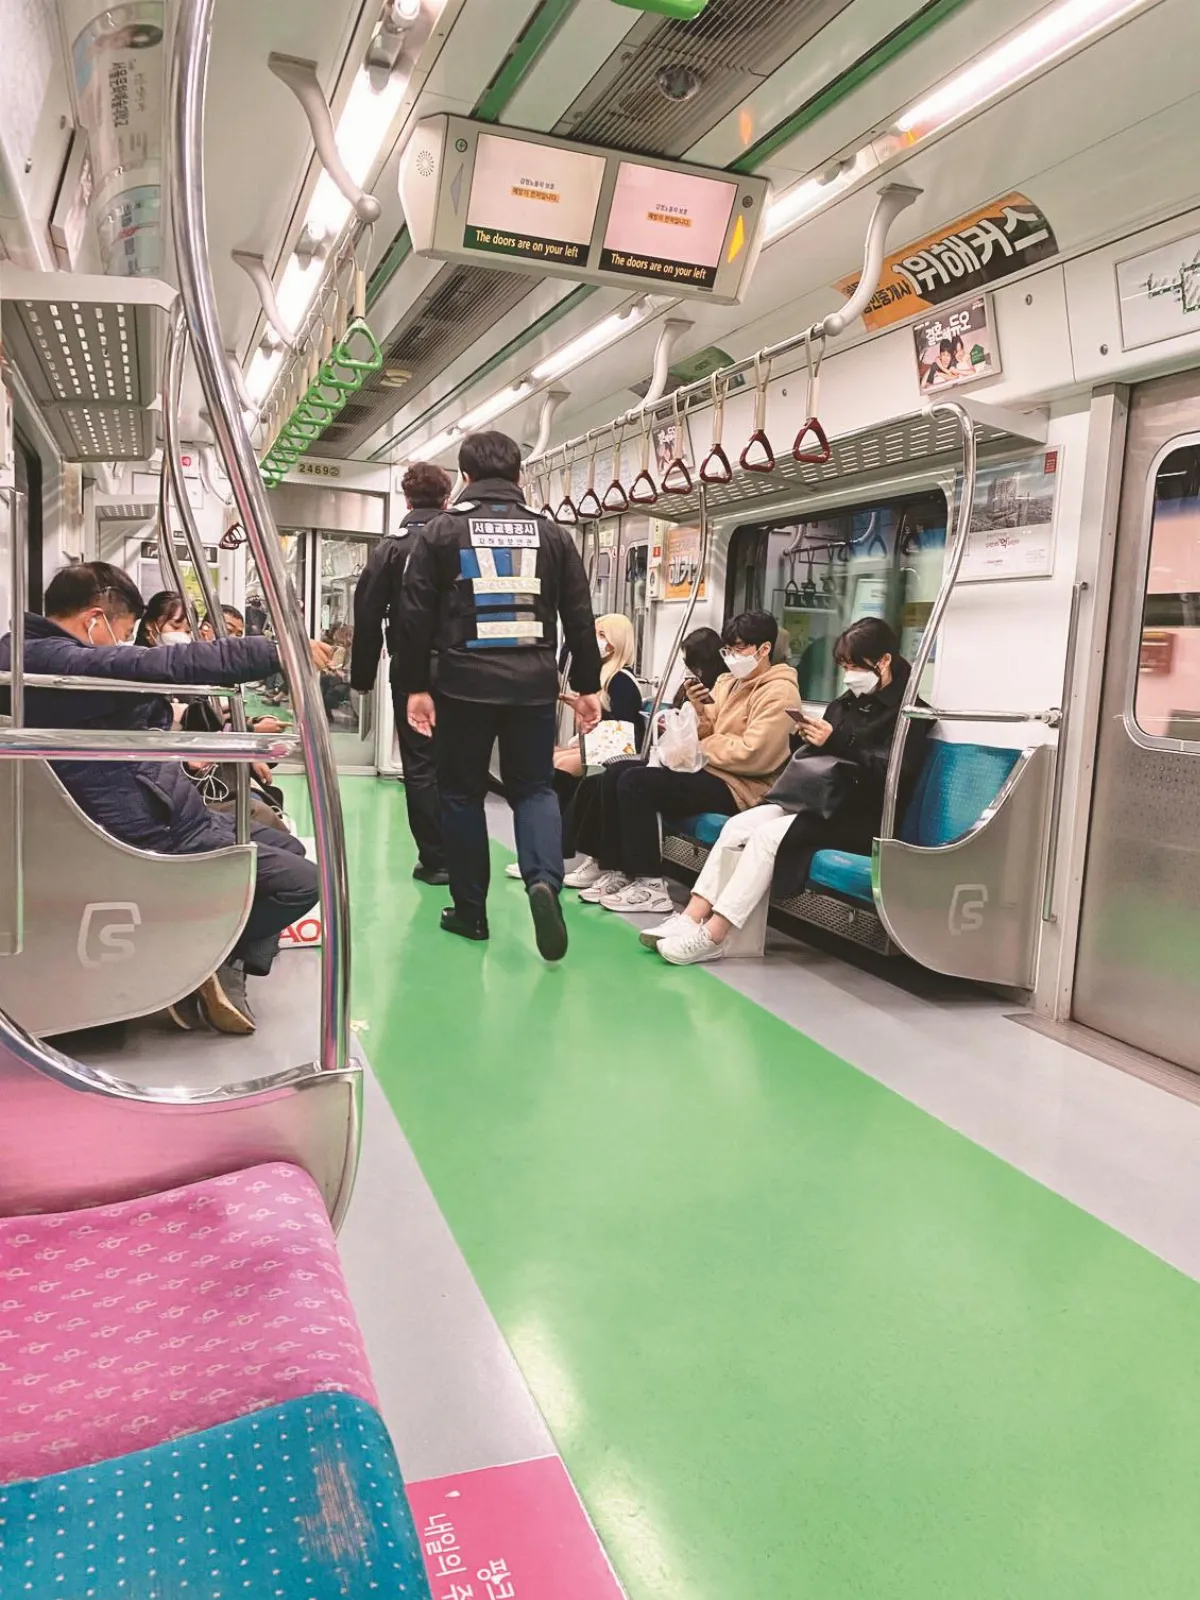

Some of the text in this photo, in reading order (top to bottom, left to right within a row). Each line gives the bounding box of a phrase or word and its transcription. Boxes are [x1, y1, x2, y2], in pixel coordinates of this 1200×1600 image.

[476, 230, 579, 258] The doors are on your left
[611, 253, 707, 279] The doors are on your left
[475, 522, 534, 535] 서울교통공사
[424, 1513, 467, 1577] 내일의
